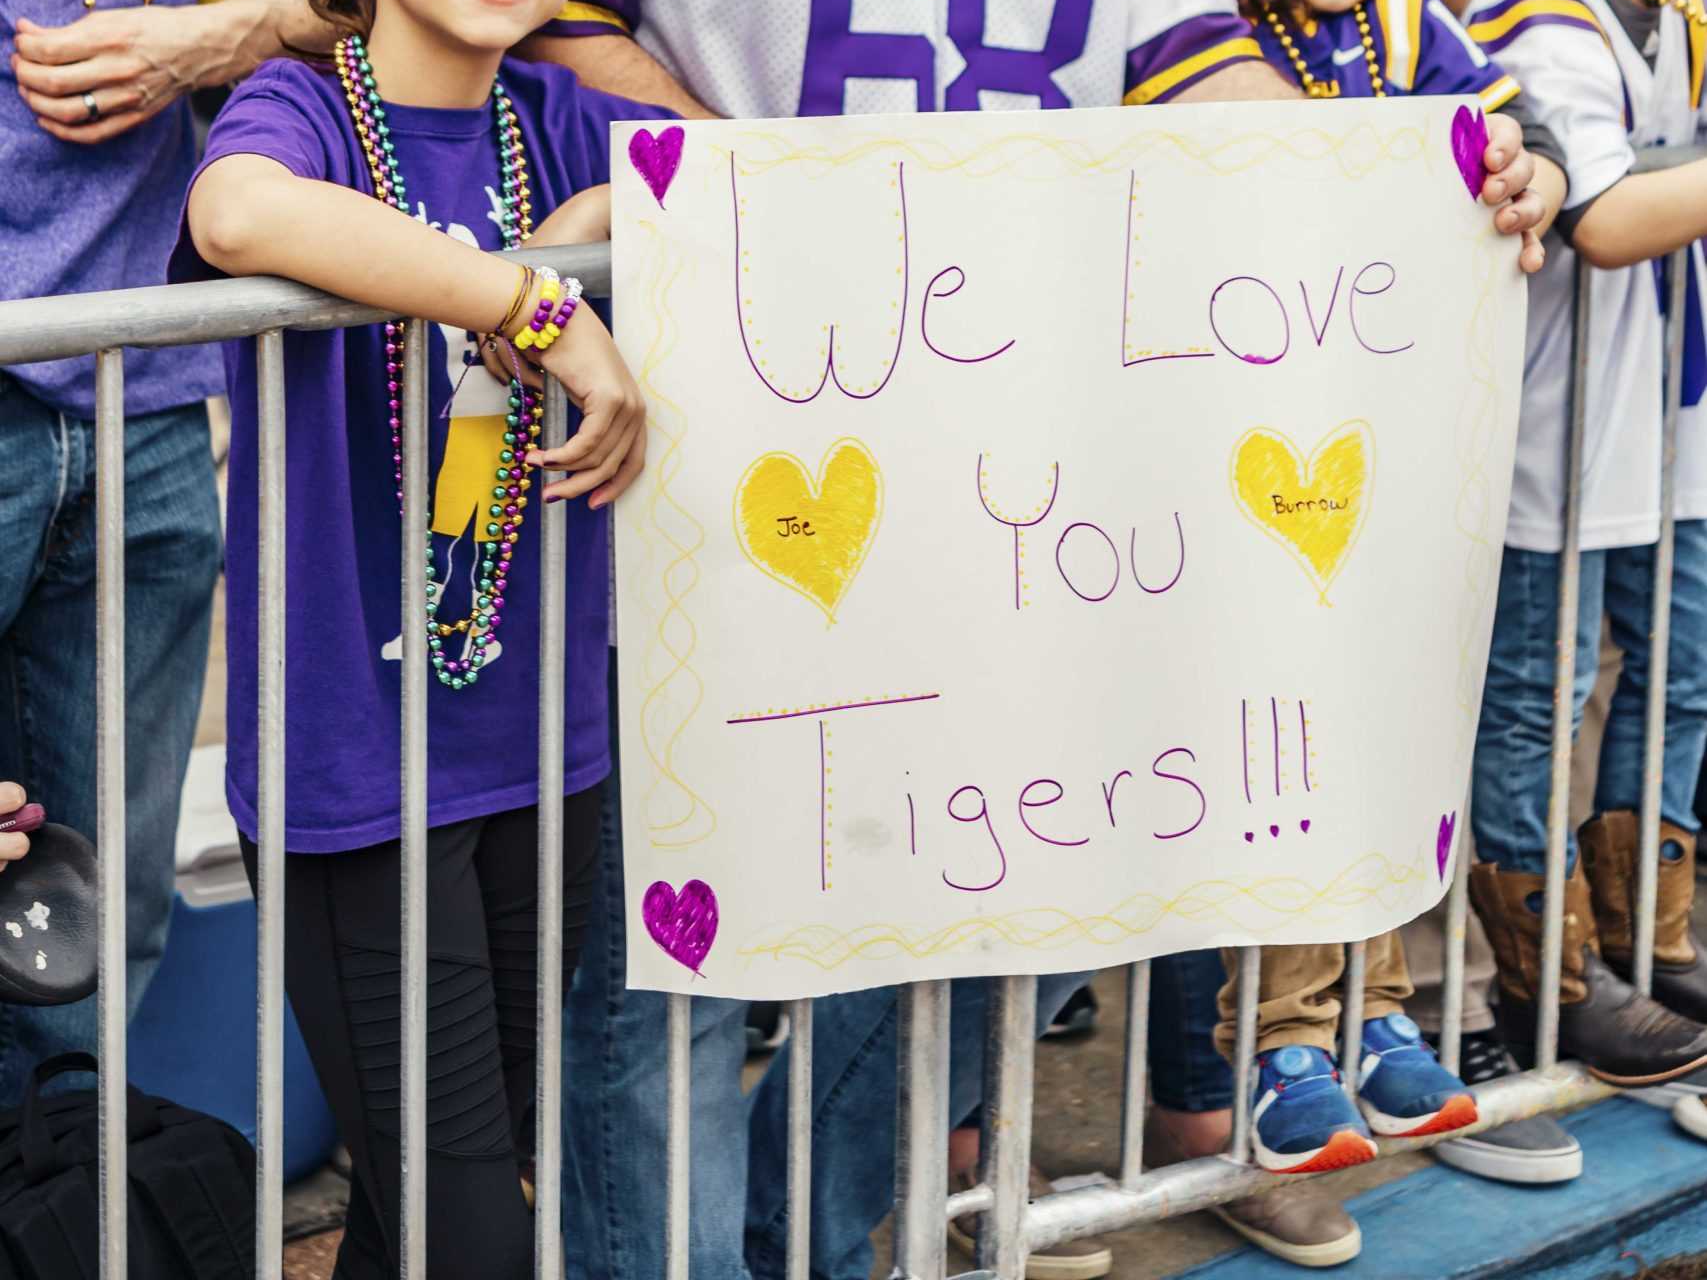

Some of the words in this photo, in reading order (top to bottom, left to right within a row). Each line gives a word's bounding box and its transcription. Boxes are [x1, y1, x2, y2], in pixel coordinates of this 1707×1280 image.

[730, 150, 1016, 404] We
[1122, 169, 1414, 367] Love
[1272, 495, 1349, 514] Burrow
[777, 516, 816, 537] Joe
